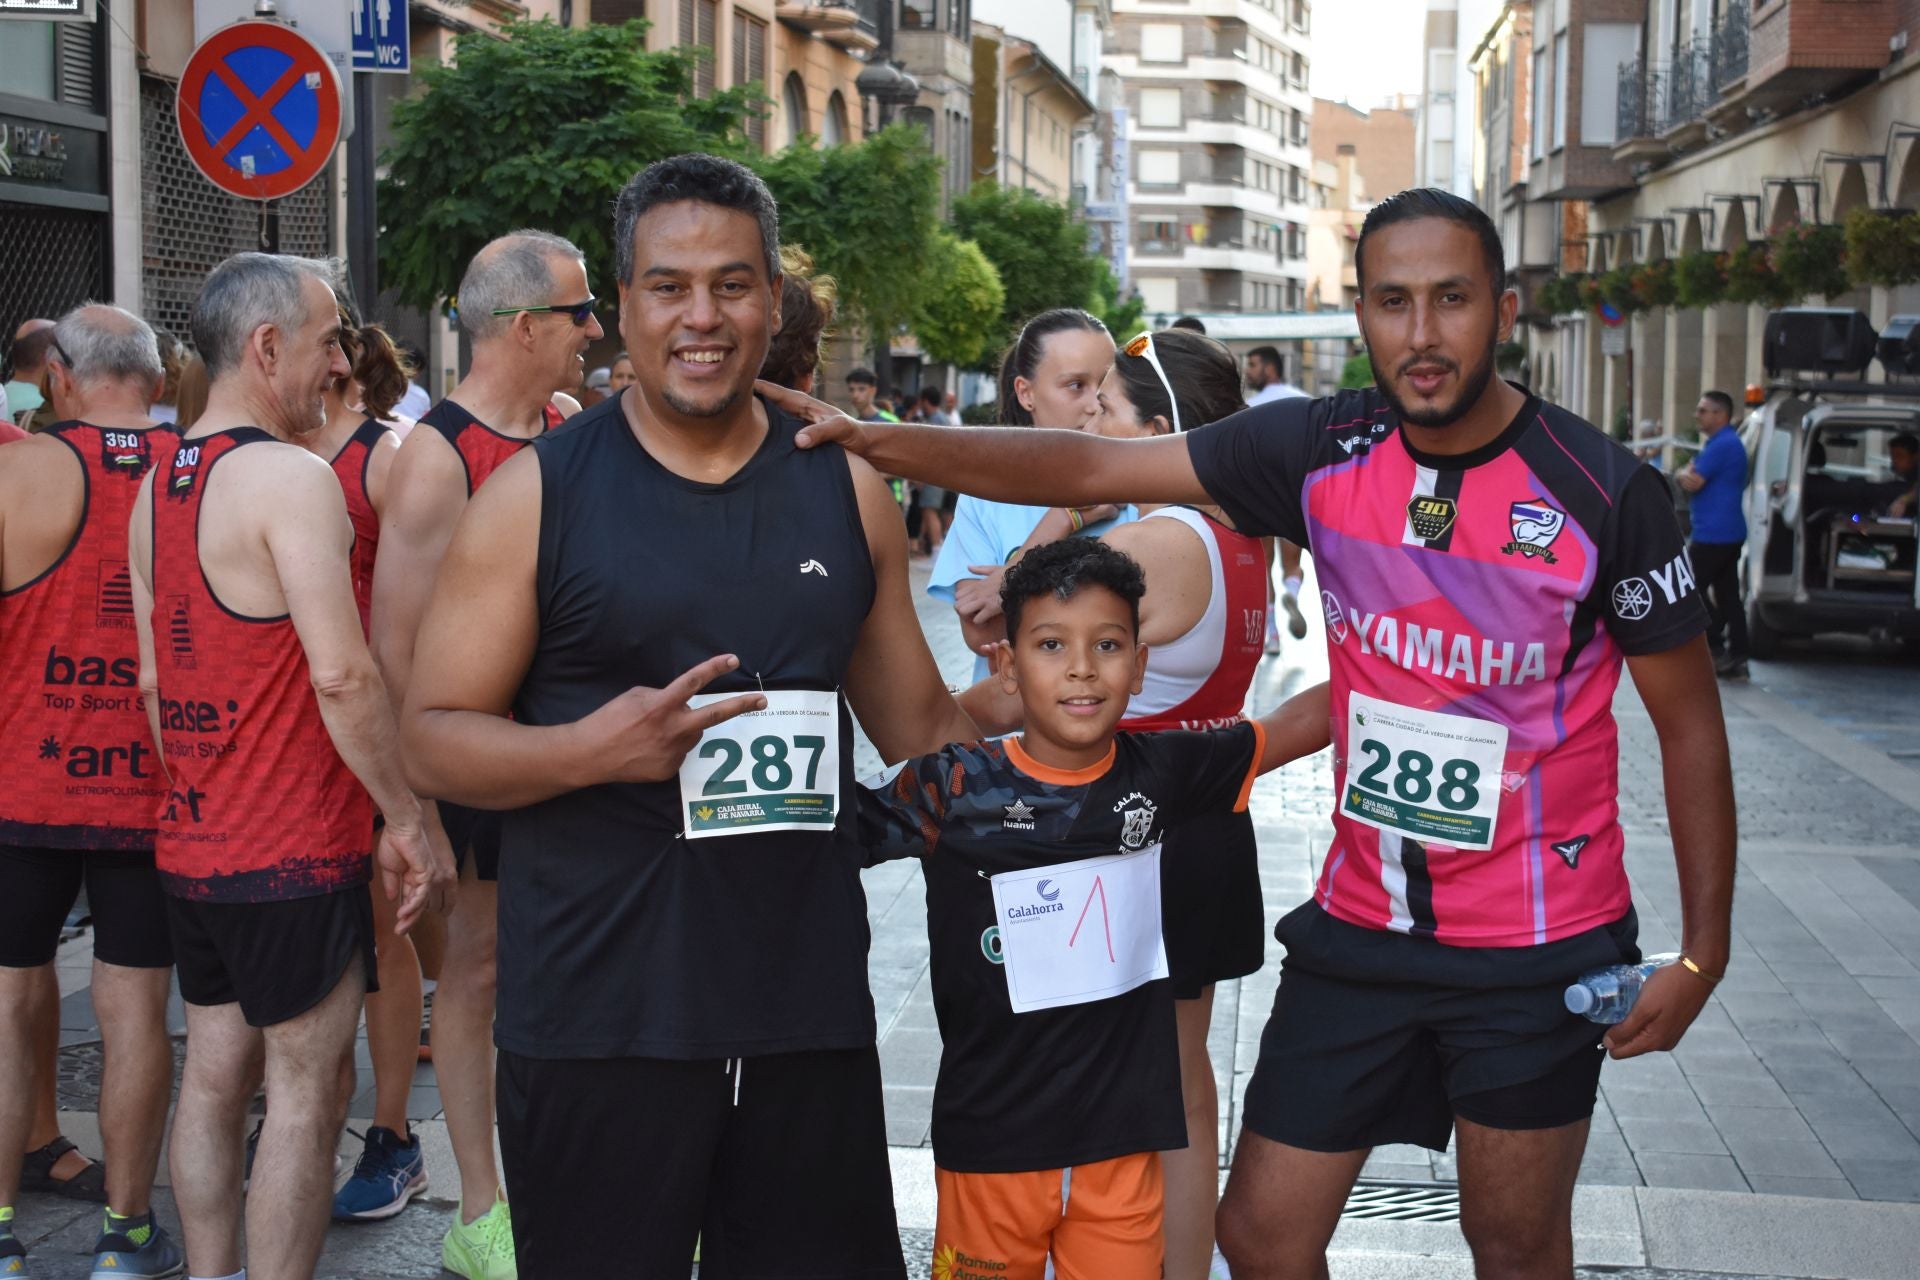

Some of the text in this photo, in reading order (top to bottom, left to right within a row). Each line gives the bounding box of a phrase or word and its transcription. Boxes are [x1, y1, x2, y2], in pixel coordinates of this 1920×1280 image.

[377, 45, 401, 65] WC
[1416, 500, 1448, 516] 90
[1350, 607, 1546, 686] YAMAHA
[43, 693, 75, 712] Top
[81, 694, 130, 712] Sport
[698, 734, 826, 797] 287
[1356, 738, 1481, 812] 288
[717, 803, 762, 813] CAJA RURAL
[717, 812, 729, 820] DE
[730, 809, 766, 819] NAVARRA
[1008, 902, 1064, 919] Calahorra
[1068, 874, 1116, 963] 1
[956, 1252, 1007, 1271] Ramiro
